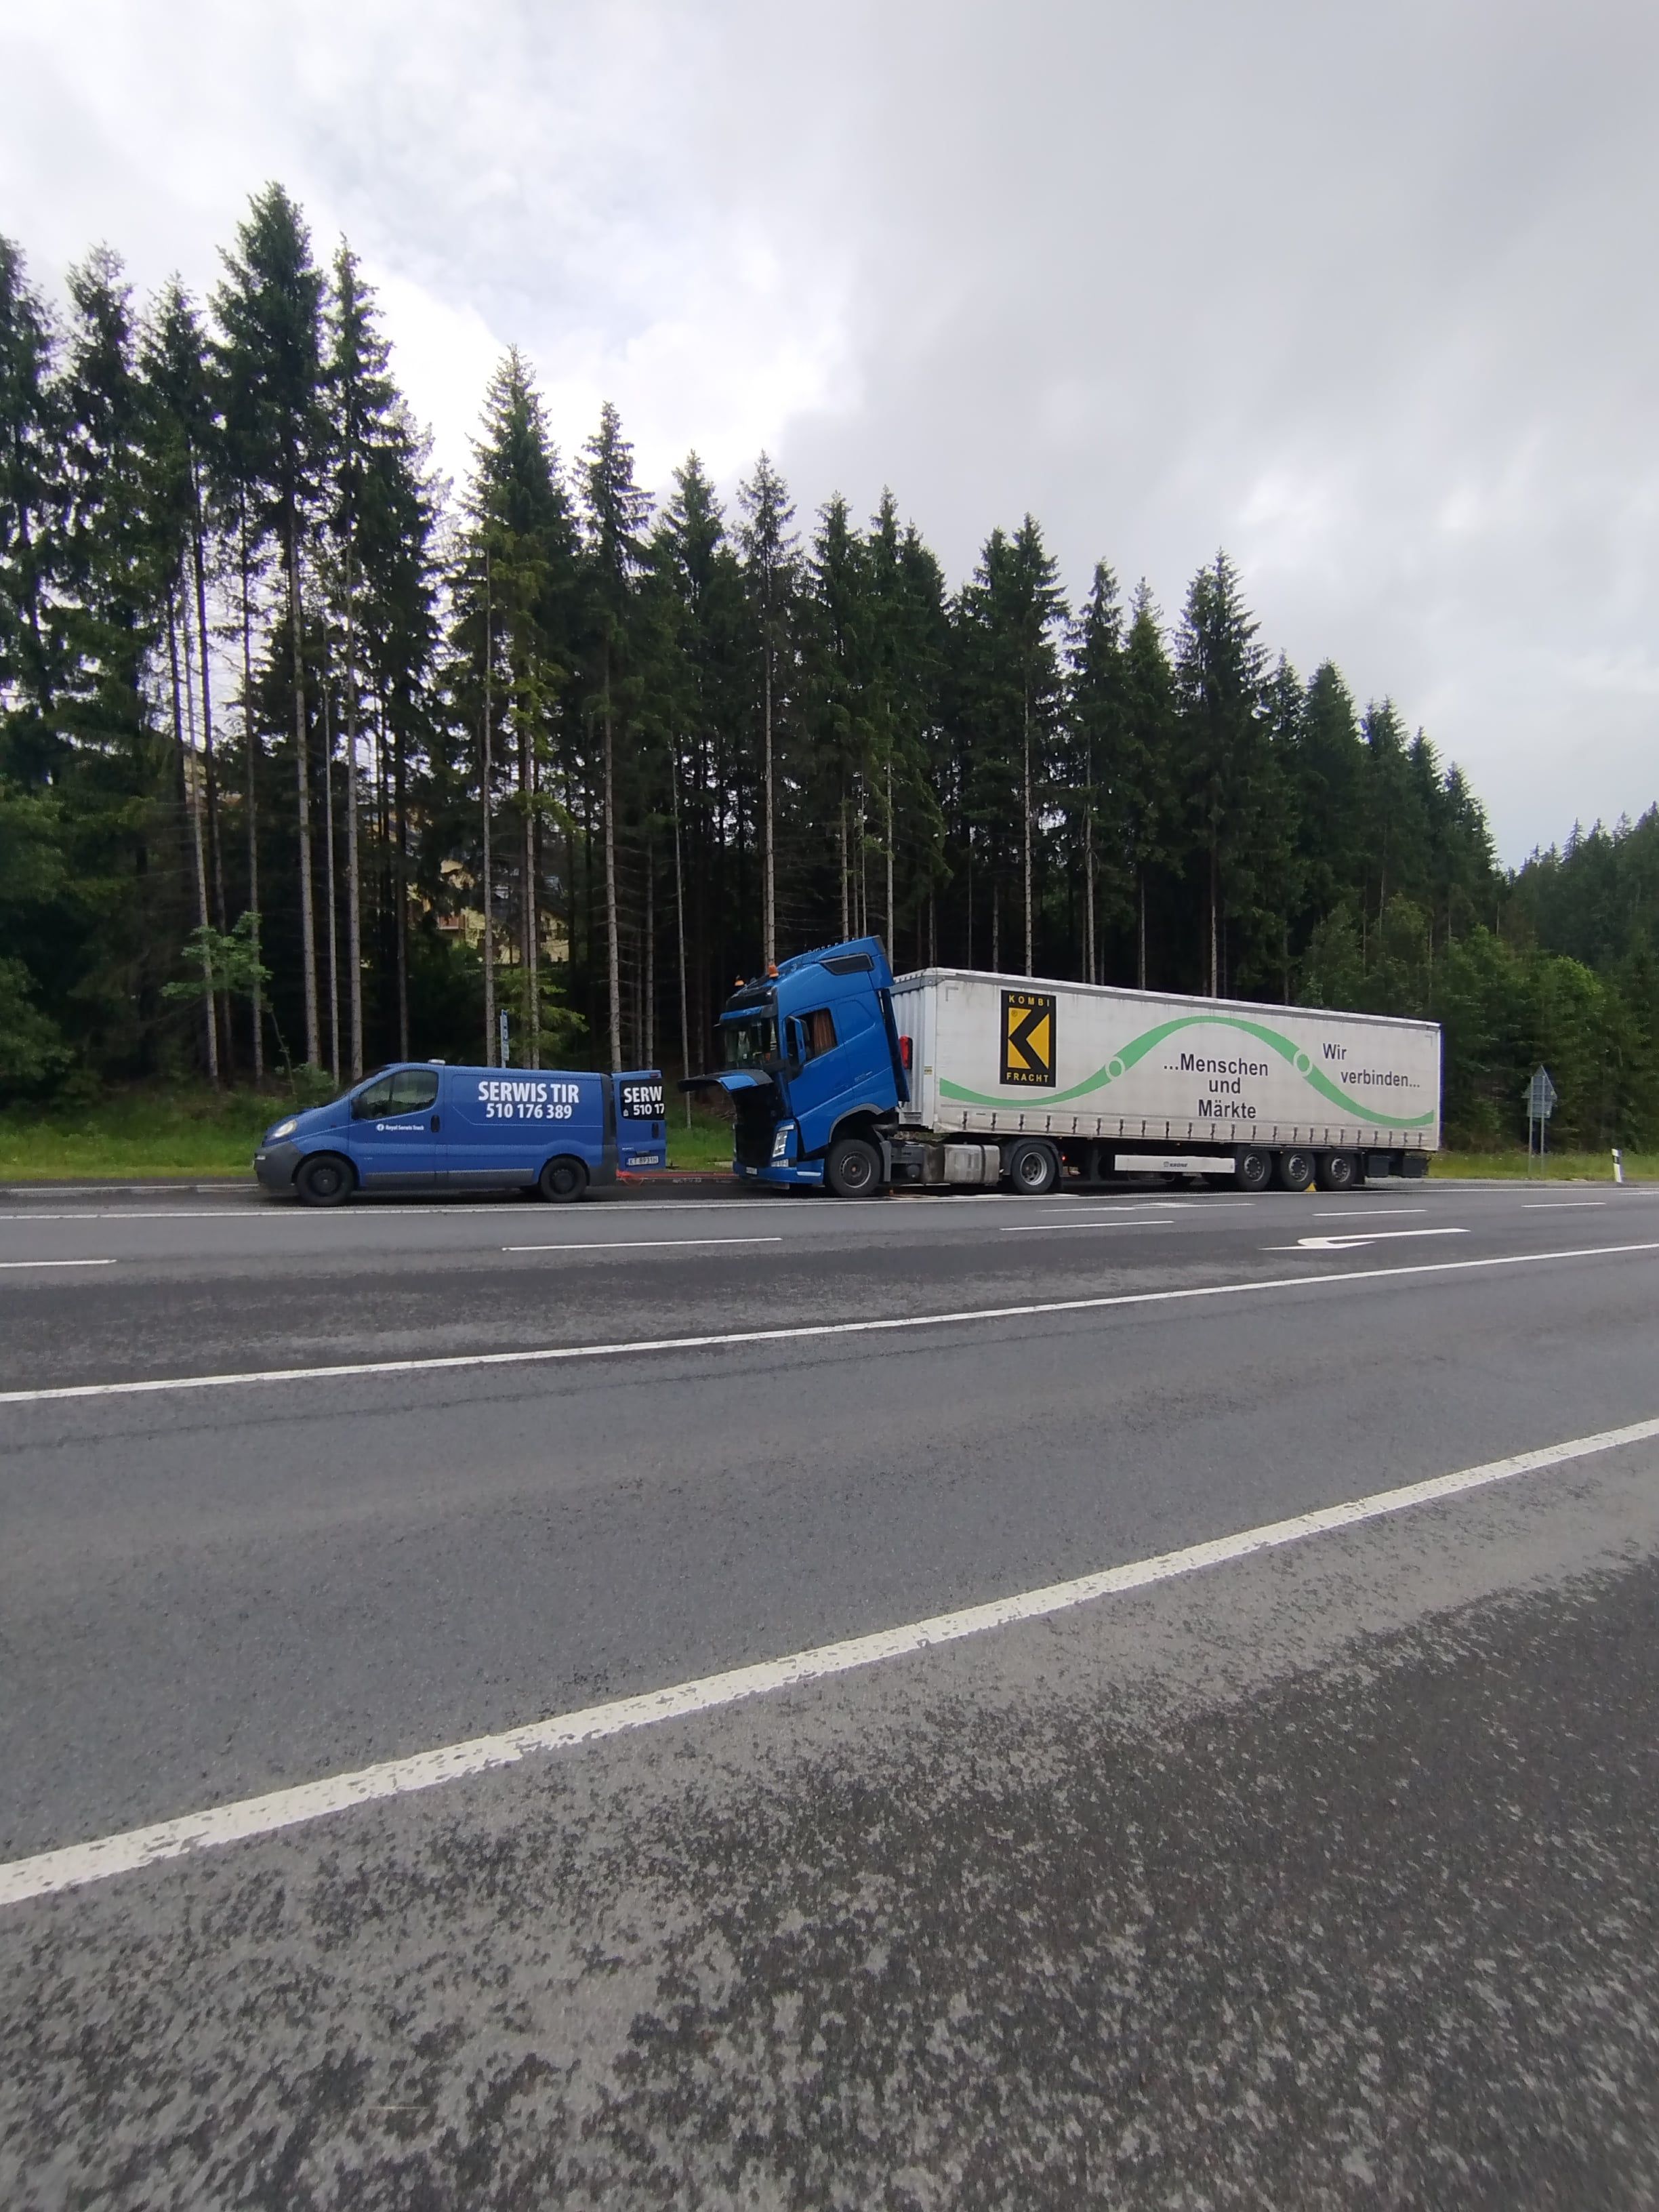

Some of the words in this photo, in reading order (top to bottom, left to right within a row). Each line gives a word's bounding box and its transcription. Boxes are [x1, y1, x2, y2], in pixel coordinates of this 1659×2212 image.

[1008, 995, 1050, 1007] KOMBI
[1323, 1043, 1347, 1060] Wir
[1164, 1053, 1269, 1076] ...Menschen
[1006, 1072, 1049, 1083] FRACHT
[1209, 1078, 1241, 1094] und
[1340, 1069, 1420, 1088] verbinden...
[478, 1081, 548, 1103] SERWIS
[550, 1084, 579, 1103] TIR
[623, 1086, 662, 1103] SERW
[486, 1103, 513, 1118] 510
[517, 1104, 543, 1119] 176
[546, 1105, 572, 1120] 389
[633, 1103, 652, 1115] 510
[1198, 1099, 1256, 1118] Märkte
